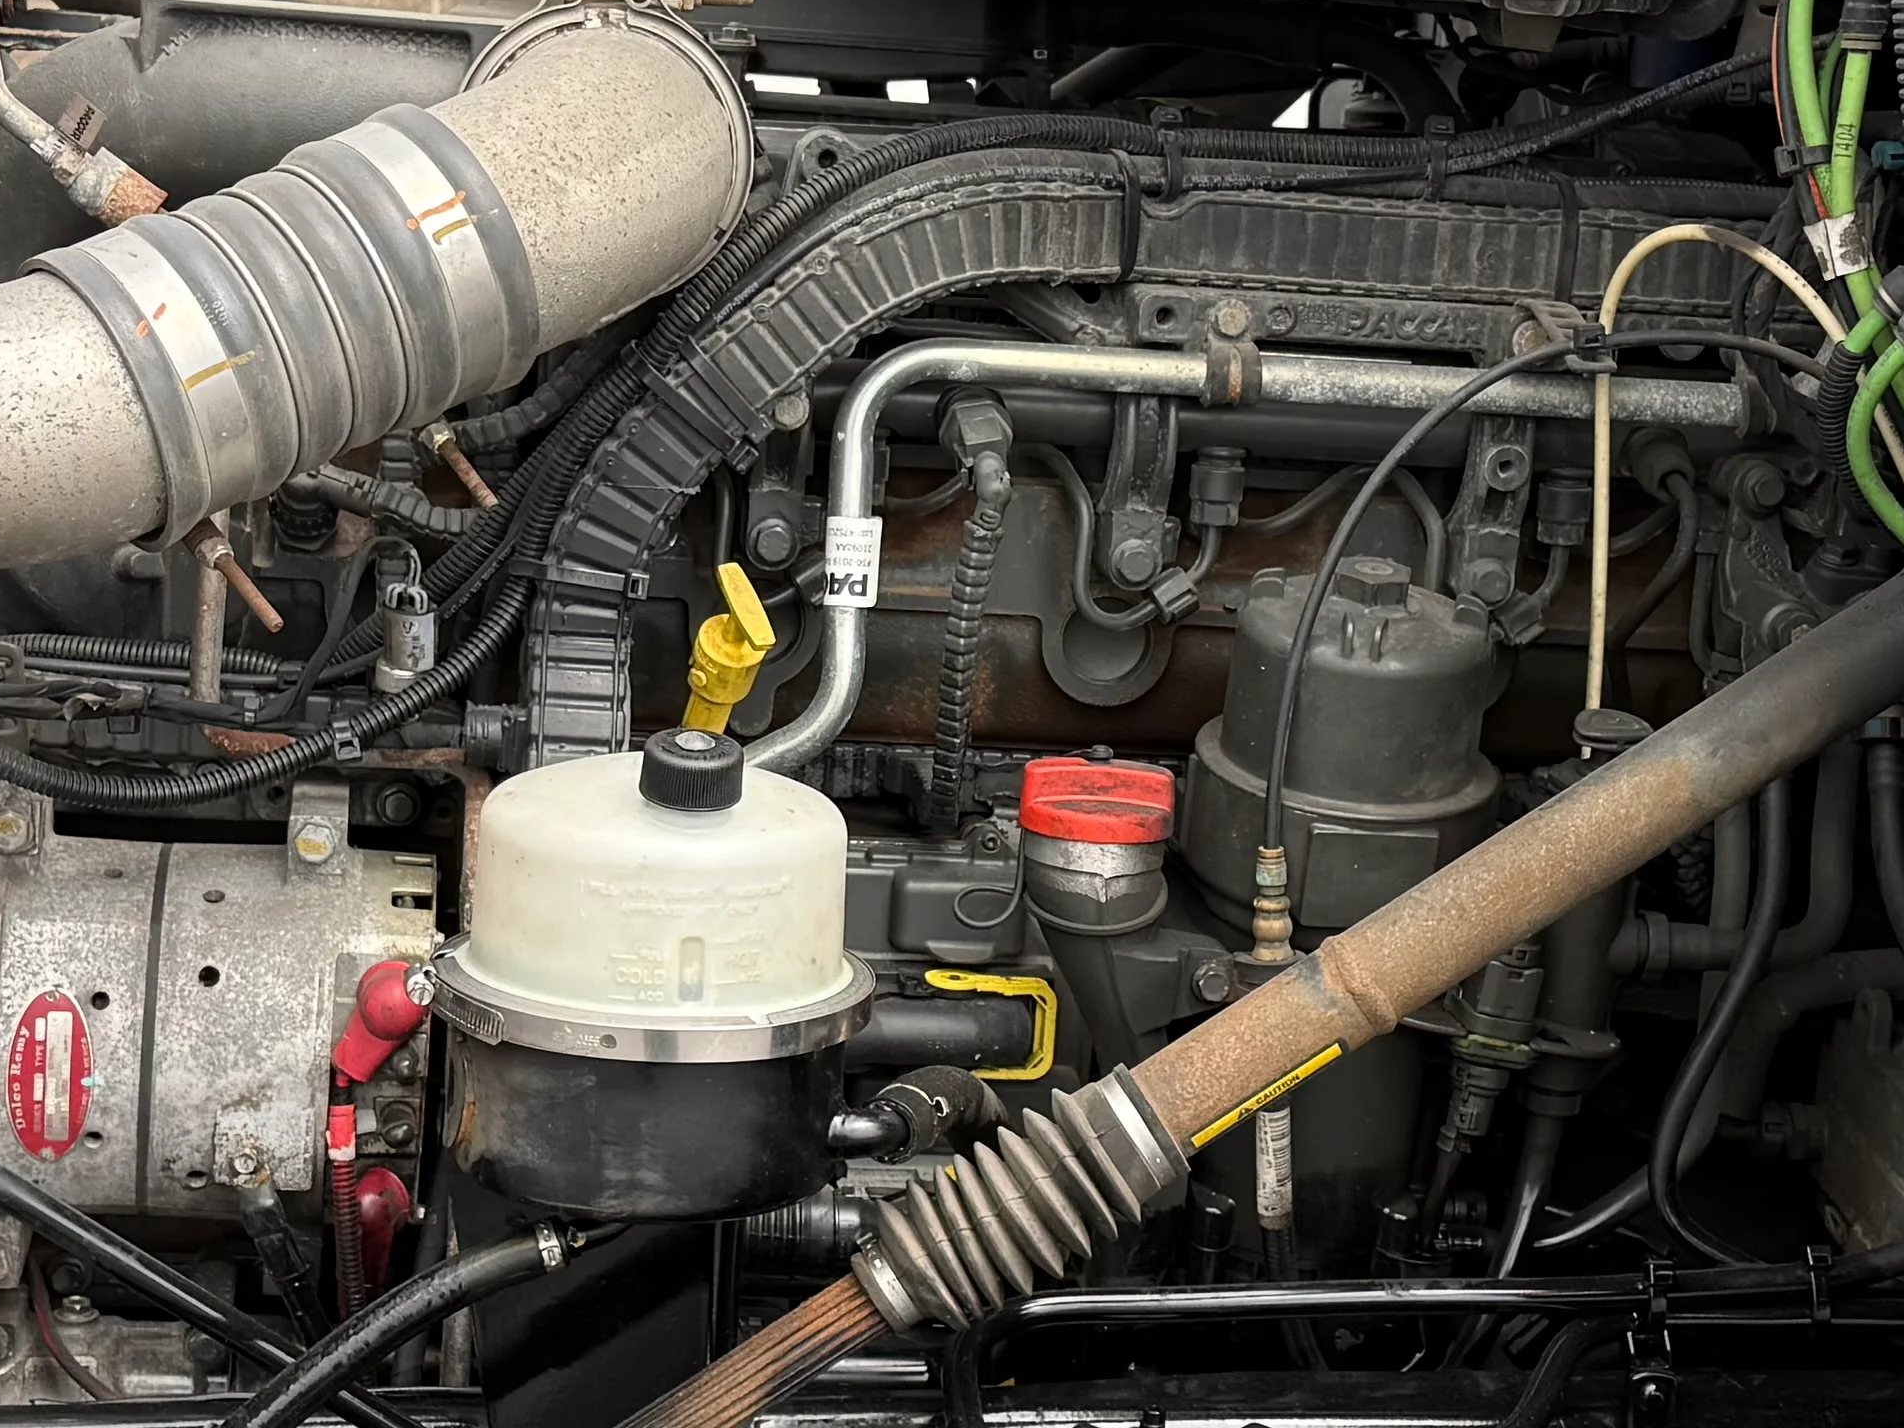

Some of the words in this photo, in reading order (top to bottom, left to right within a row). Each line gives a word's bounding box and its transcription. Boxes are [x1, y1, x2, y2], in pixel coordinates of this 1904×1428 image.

[1835, 123, 1856, 158] 1404
[829, 572, 868, 597] PA
[615, 966, 666, 985] COLD
[1256, 1073, 1300, 1105] CAUTION
